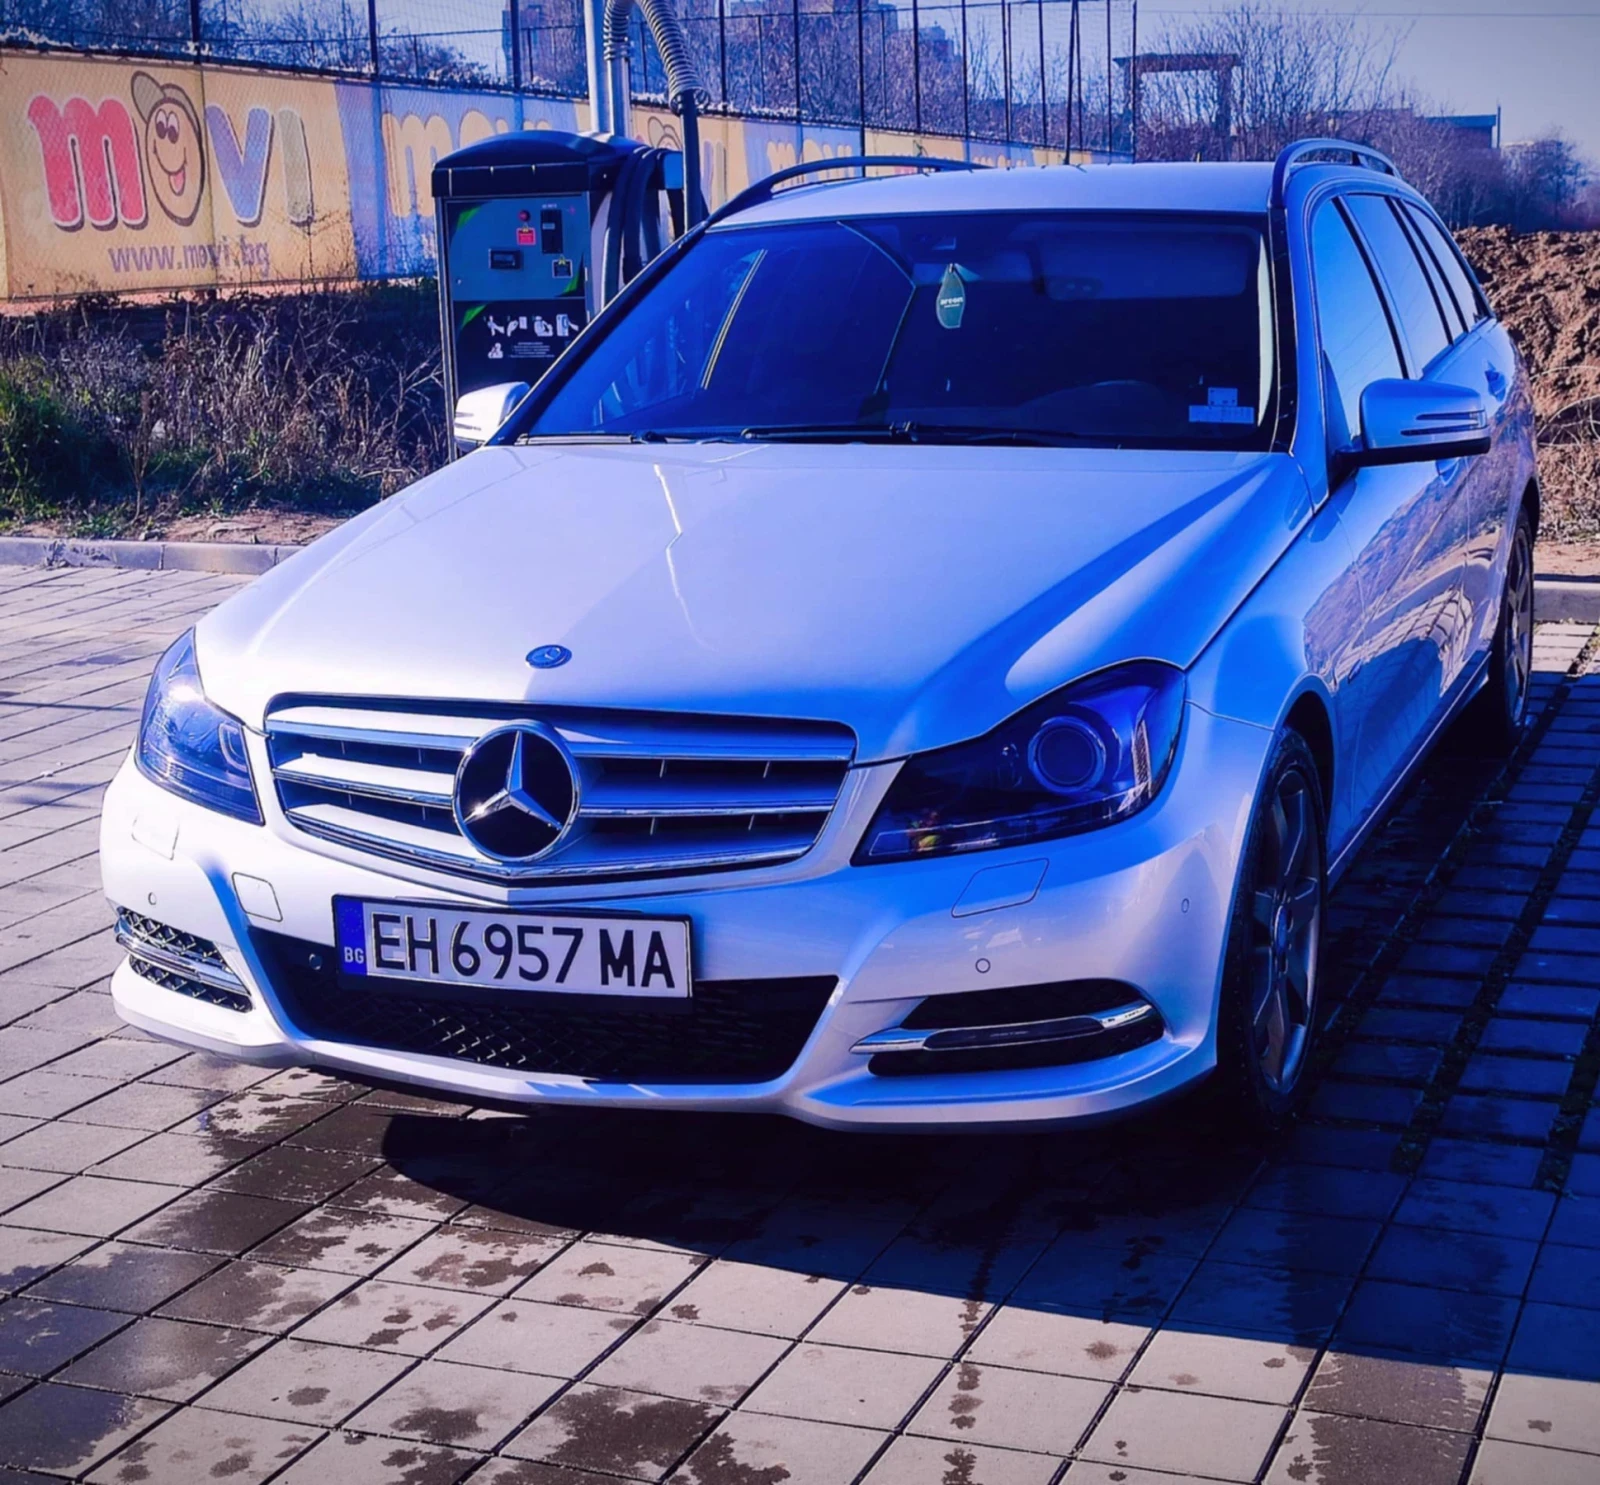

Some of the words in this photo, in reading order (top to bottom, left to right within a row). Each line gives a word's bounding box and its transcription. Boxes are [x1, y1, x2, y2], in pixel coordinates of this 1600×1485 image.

[344, 946, 364, 964] BG
[372, 912, 440, 974] EH
[452, 921, 584, 984] 6957
[599, 929, 675, 988] MA
